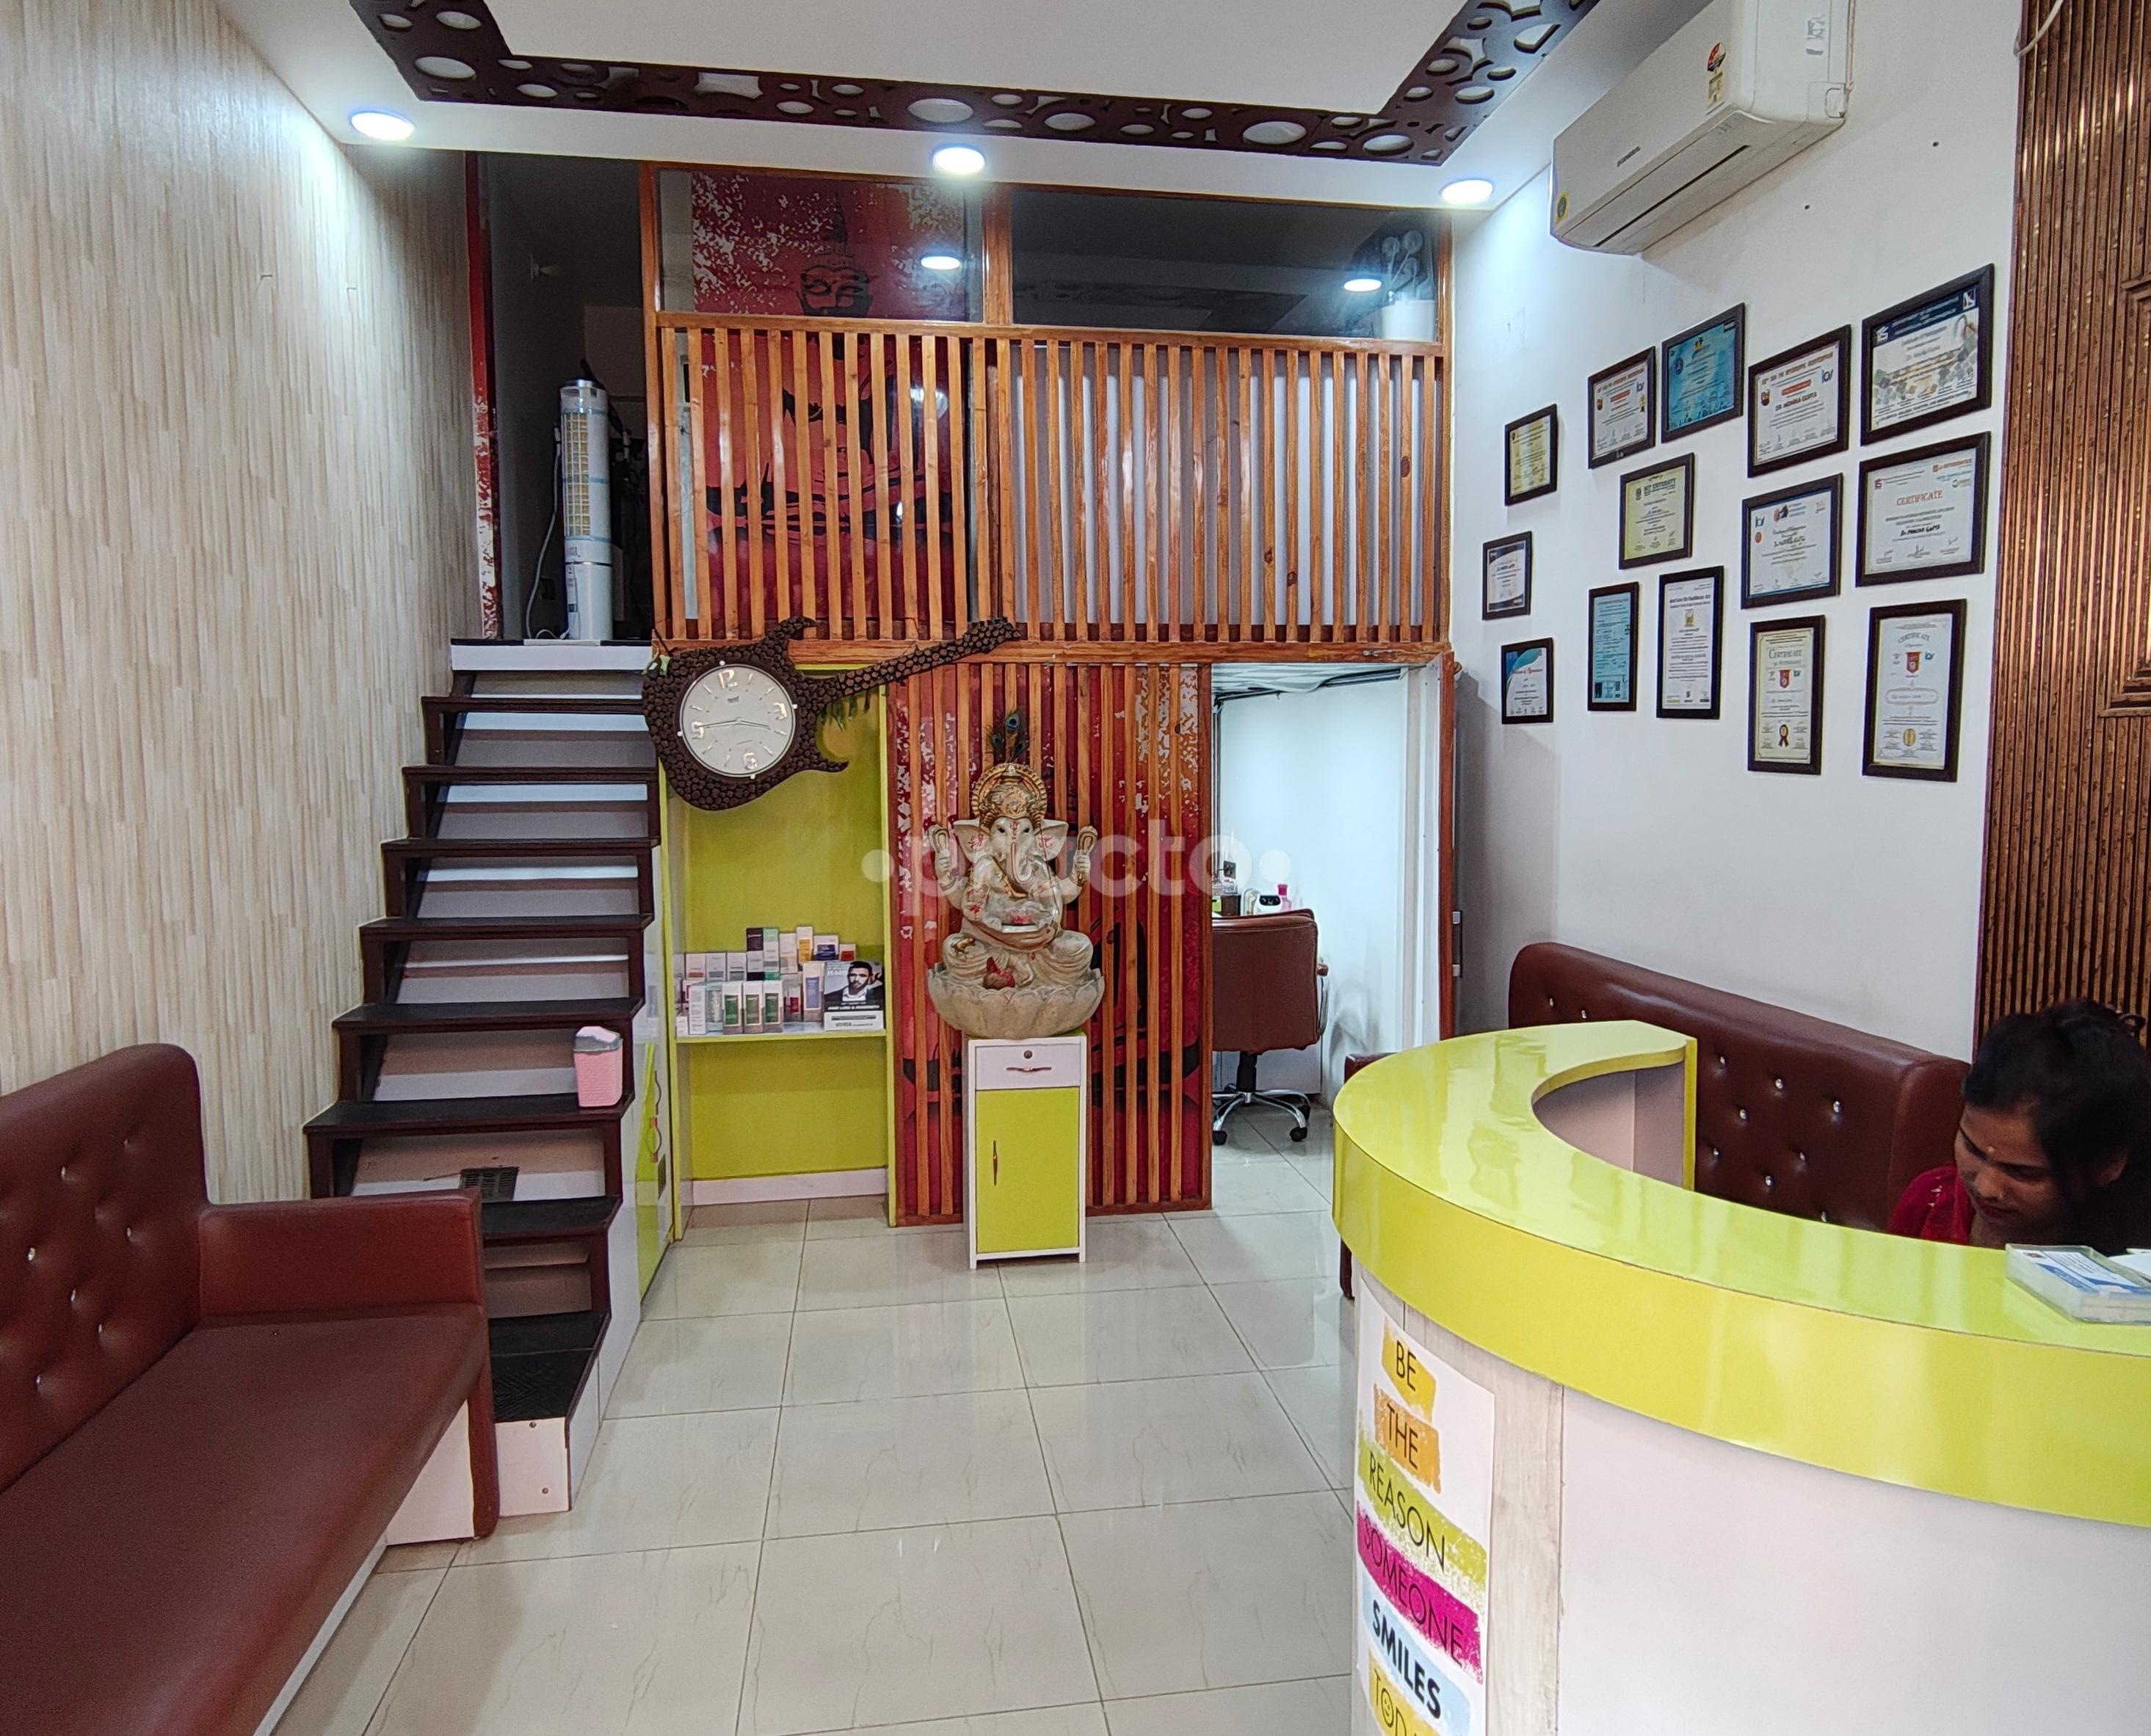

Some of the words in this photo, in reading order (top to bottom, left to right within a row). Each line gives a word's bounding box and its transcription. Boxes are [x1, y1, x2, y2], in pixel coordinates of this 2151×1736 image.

[1896, 490, 1943, 506] CERTIFICATE
[1396, 1340, 1417, 1392] BE
[1387, 1403, 1418, 1470] THE
[1370, 1450, 1445, 1574] REASON
[1365, 1514, 1463, 1668] SOMEONE
[1373, 1599, 1441, 1719] SMILES
[1374, 1668, 1417, 1736] TOD
